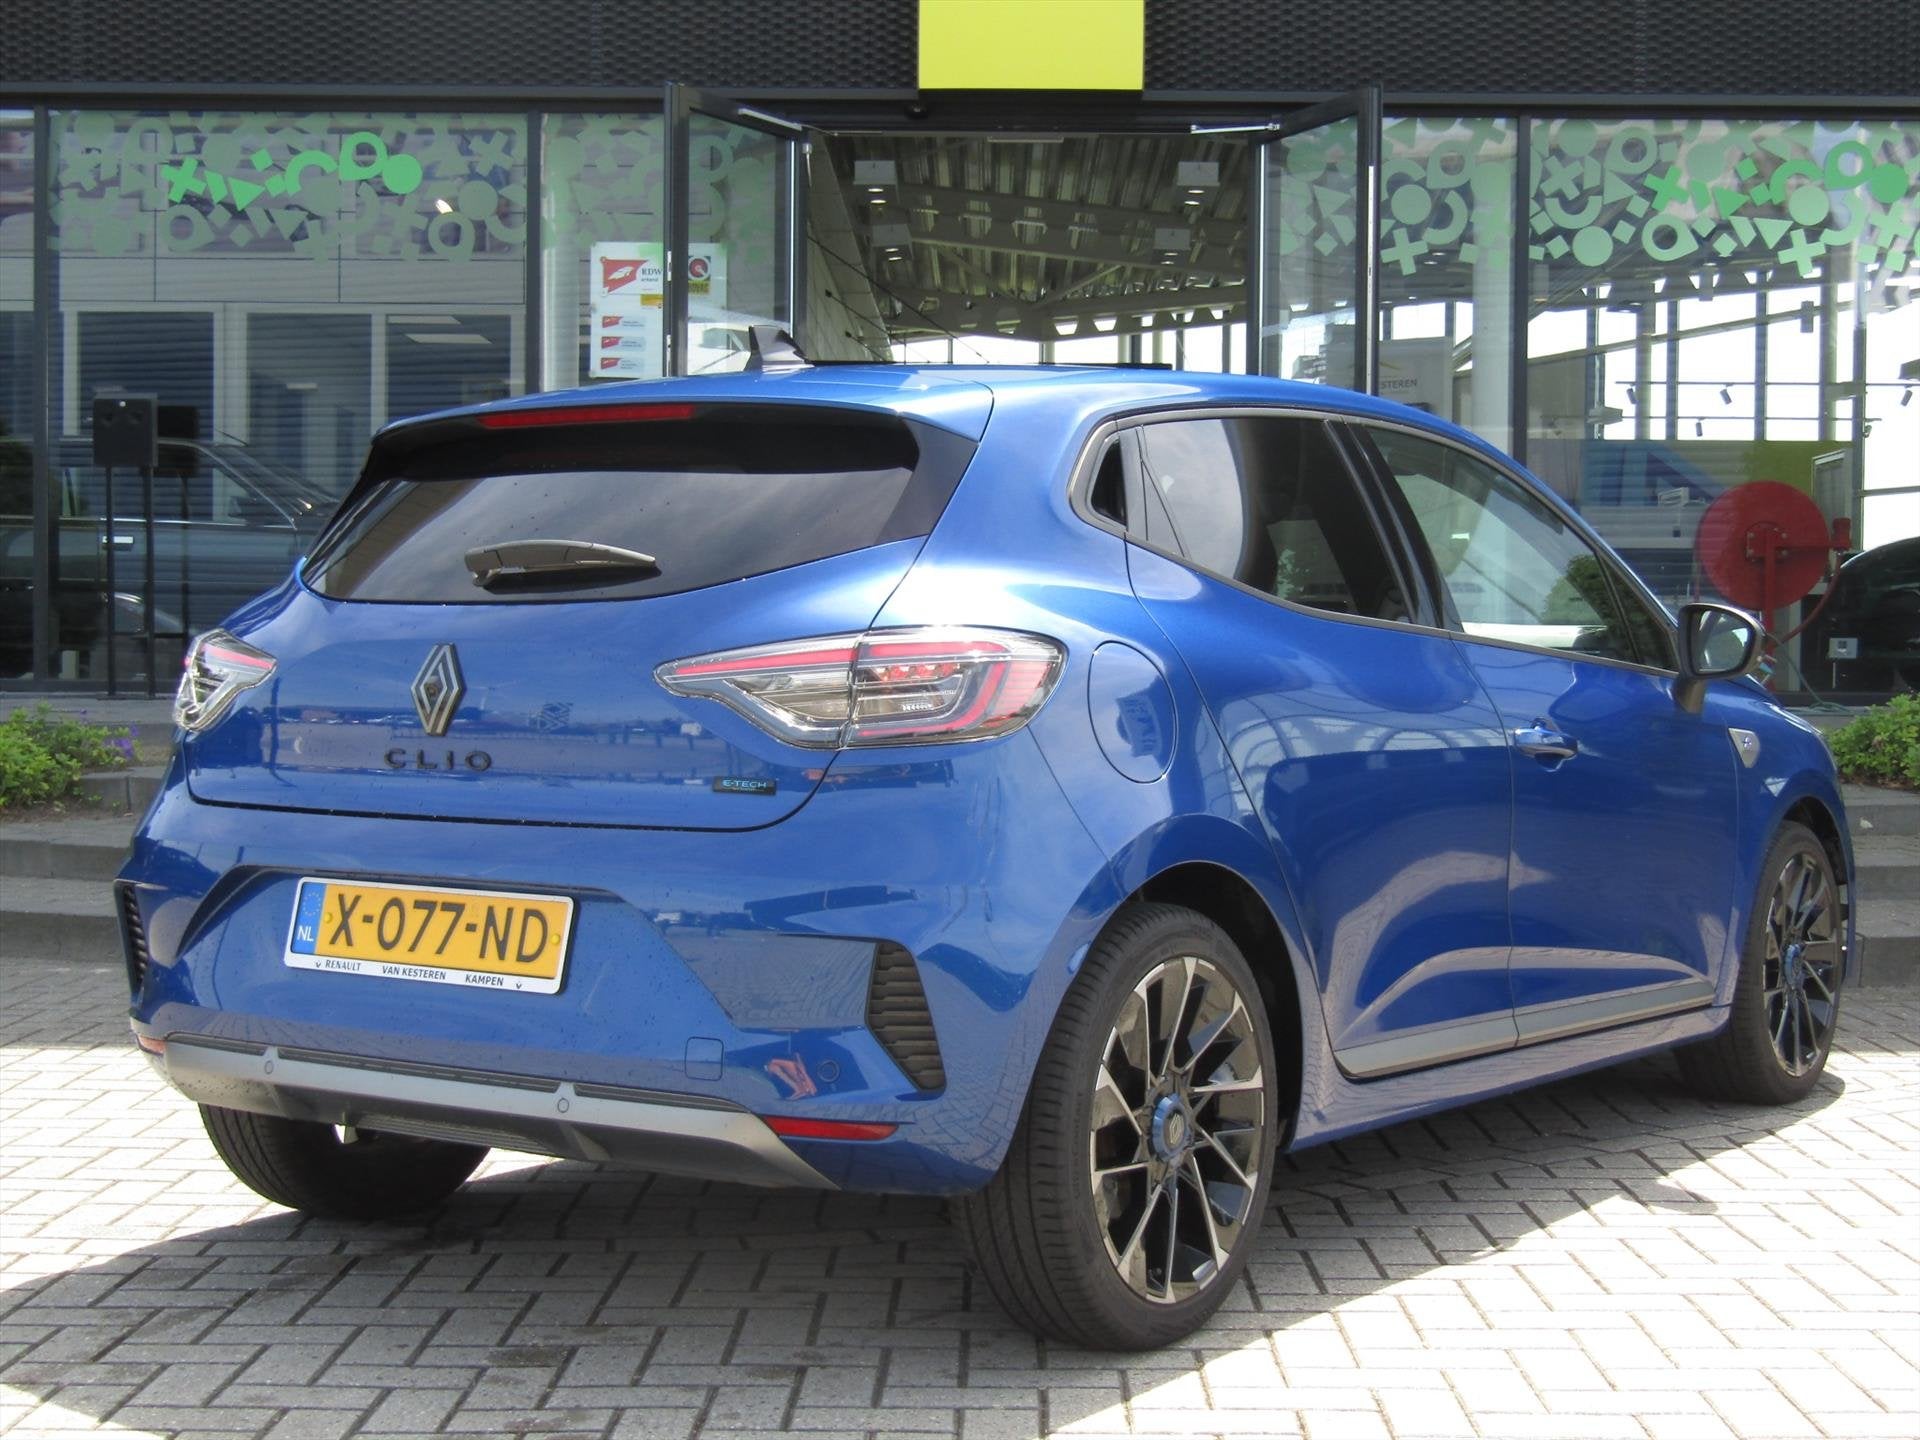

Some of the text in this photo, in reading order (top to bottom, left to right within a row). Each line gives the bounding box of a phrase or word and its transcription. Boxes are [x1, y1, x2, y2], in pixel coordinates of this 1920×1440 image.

[641, 267, 662, 276] RDW
[1380, 378, 1418, 390] STEREN
[384, 747, 492, 772] CLIO
[722, 779, 767, 788] E-TECH
[297, 925, 314, 942] NL
[329, 893, 549, 963] X-077-ND
[325, 959, 504, 987] RENAULT VAN KESTEREN KAMPEN
